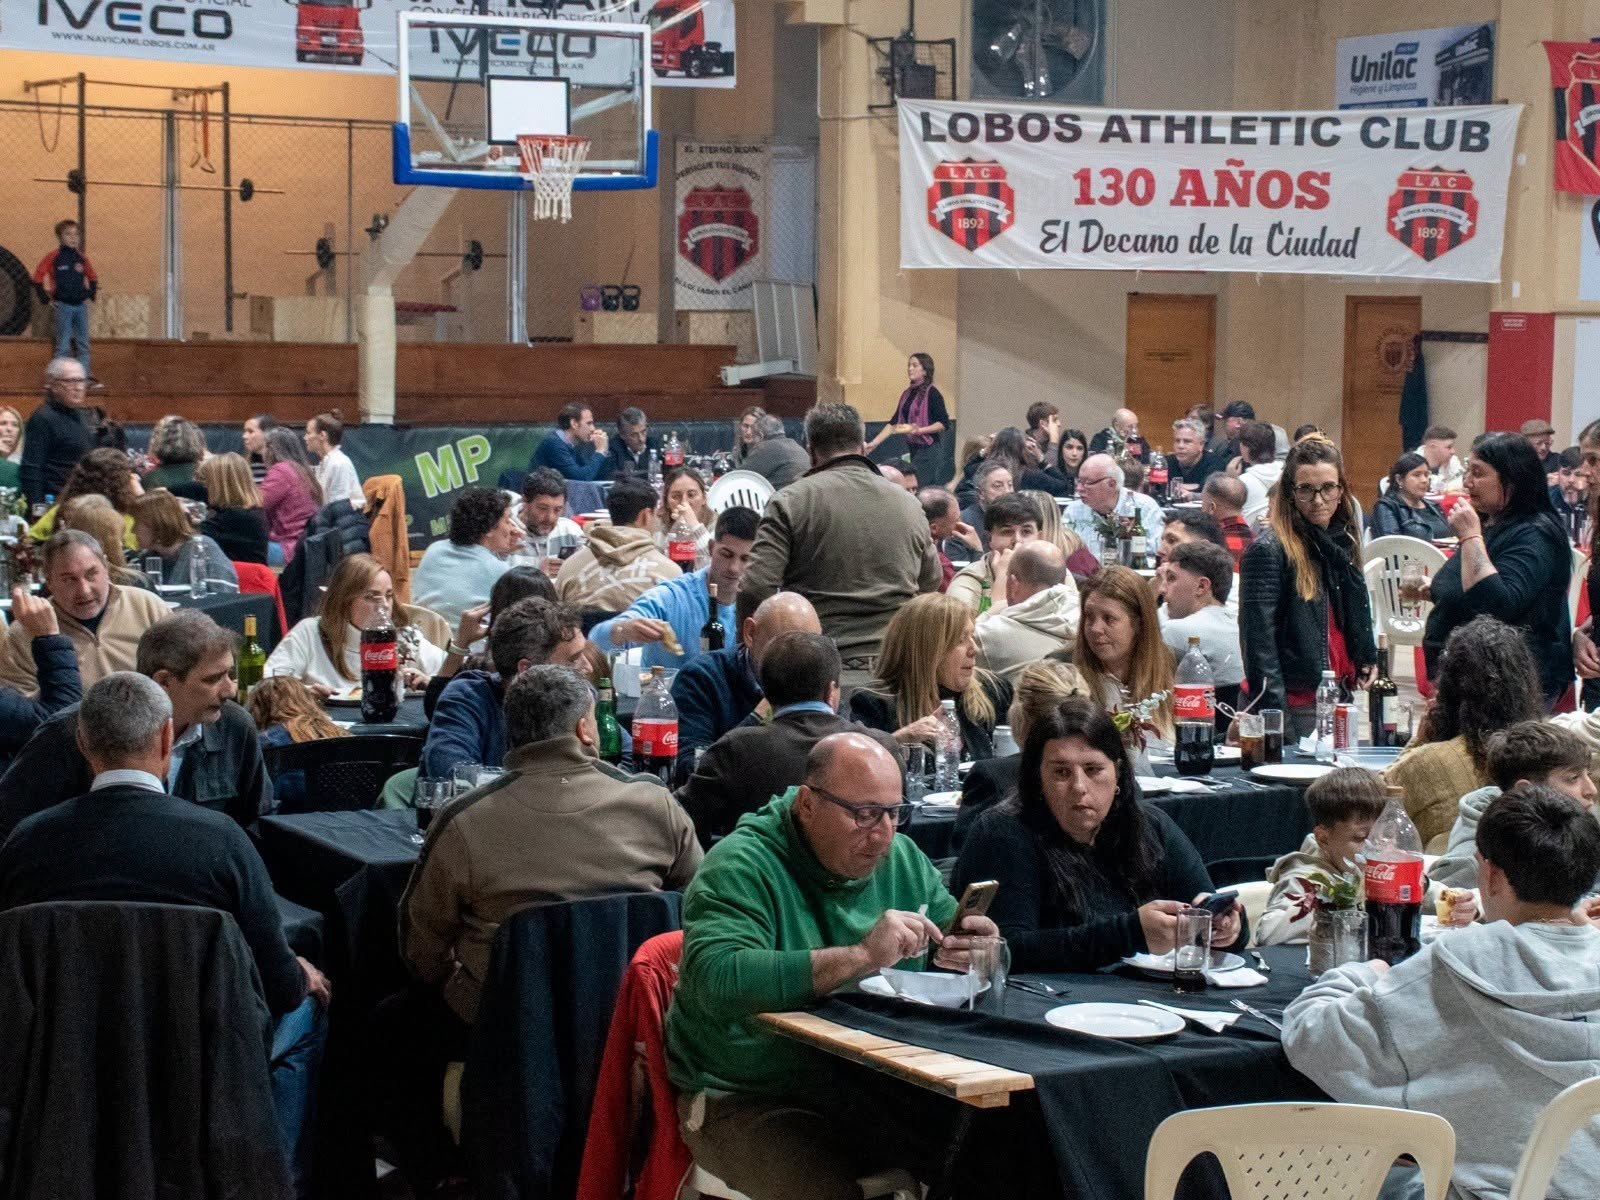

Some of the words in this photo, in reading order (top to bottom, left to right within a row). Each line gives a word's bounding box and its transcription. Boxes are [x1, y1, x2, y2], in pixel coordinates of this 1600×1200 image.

[38, 0, 233, 40] IVECO
[1350, 51, 1418, 83] Unilac
[920, 111, 1083, 143] LOBOS
[1099, 114, 1342, 148] ATHLETIC
[1359, 116, 1491, 153] CLUB
[1073, 167, 1156, 207] 130
[1169, 157, 1331, 211] AÑOS
[957, 217, 985, 229] 1892
[1039, 218, 1068, 254] El
[1077, 218, 1179, 254] Decano
[1188, 222, 1220, 255] de
[1229, 224, 1254, 256] la
[1266, 220, 1362, 260] Ciudad
[1417, 226, 1445, 239] 1892
[414, 434, 492, 499] MP
[364, 647, 395, 662] Coca-Cola
